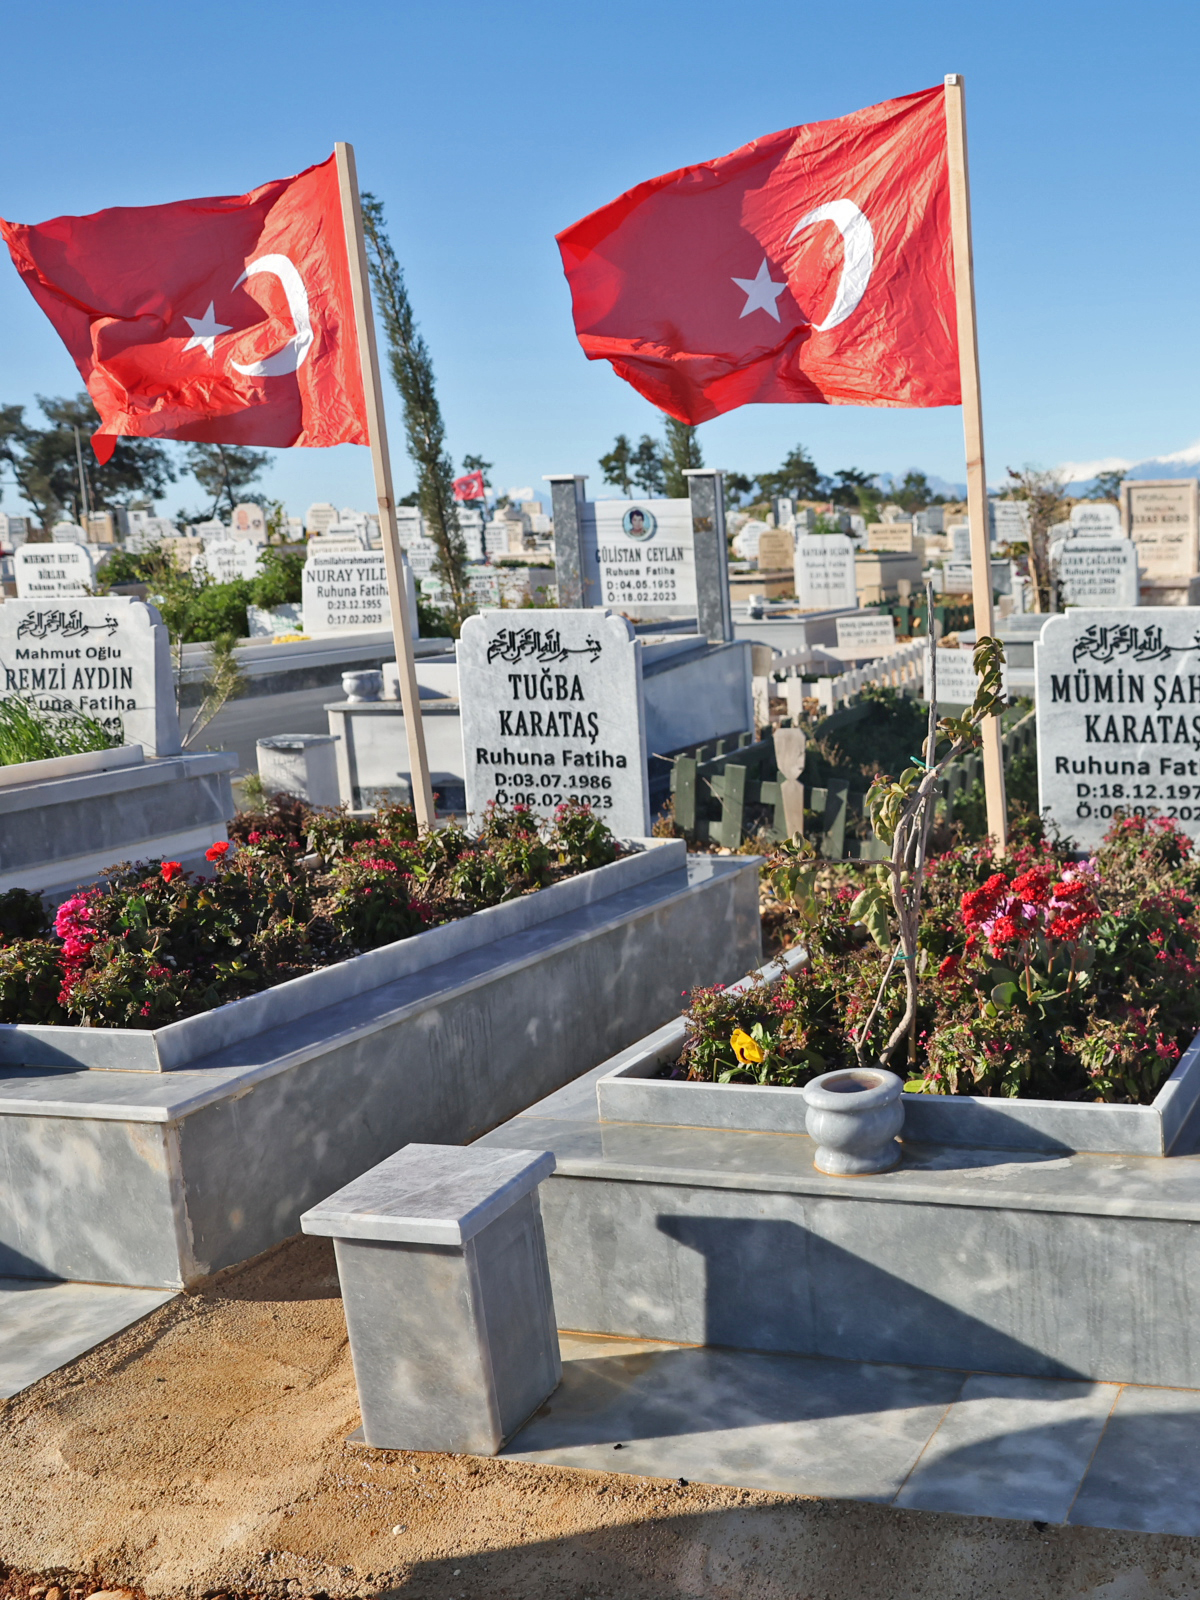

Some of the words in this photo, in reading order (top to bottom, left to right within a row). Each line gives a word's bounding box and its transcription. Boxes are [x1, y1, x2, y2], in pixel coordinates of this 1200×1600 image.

[595, 546, 641, 563] GÜLİSTAN
[647, 547, 684, 562] CEYLAN
[307, 568, 353, 582] NURAY
[606, 567, 640, 577] Ruhuna
[646, 566, 675, 576] Fatiha
[318, 585, 356, 597] Ruhuna
[328, 600, 382, 610] D:23.12.1955
[16, 648, 81, 660] Mahmut
[86, 647, 121, 660] Oğlu
[6, 663, 66, 690] REMZİ
[72, 667, 133, 690] AYDIN
[508, 667, 585, 700] TUĞBA
[1051, 668, 1144, 703] MÜMİN
[80, 695, 136, 710] Fatiha
[499, 710, 599, 745] KARATAŞ
[476, 748, 555, 766] Ruhuna
[562, 750, 627, 768] Fatiha
[1055, 756, 1150, 775] Ruhuna
[495, 772, 612, 789] D:03.07.1986
[495, 789, 613, 808] Ö:06.022023
